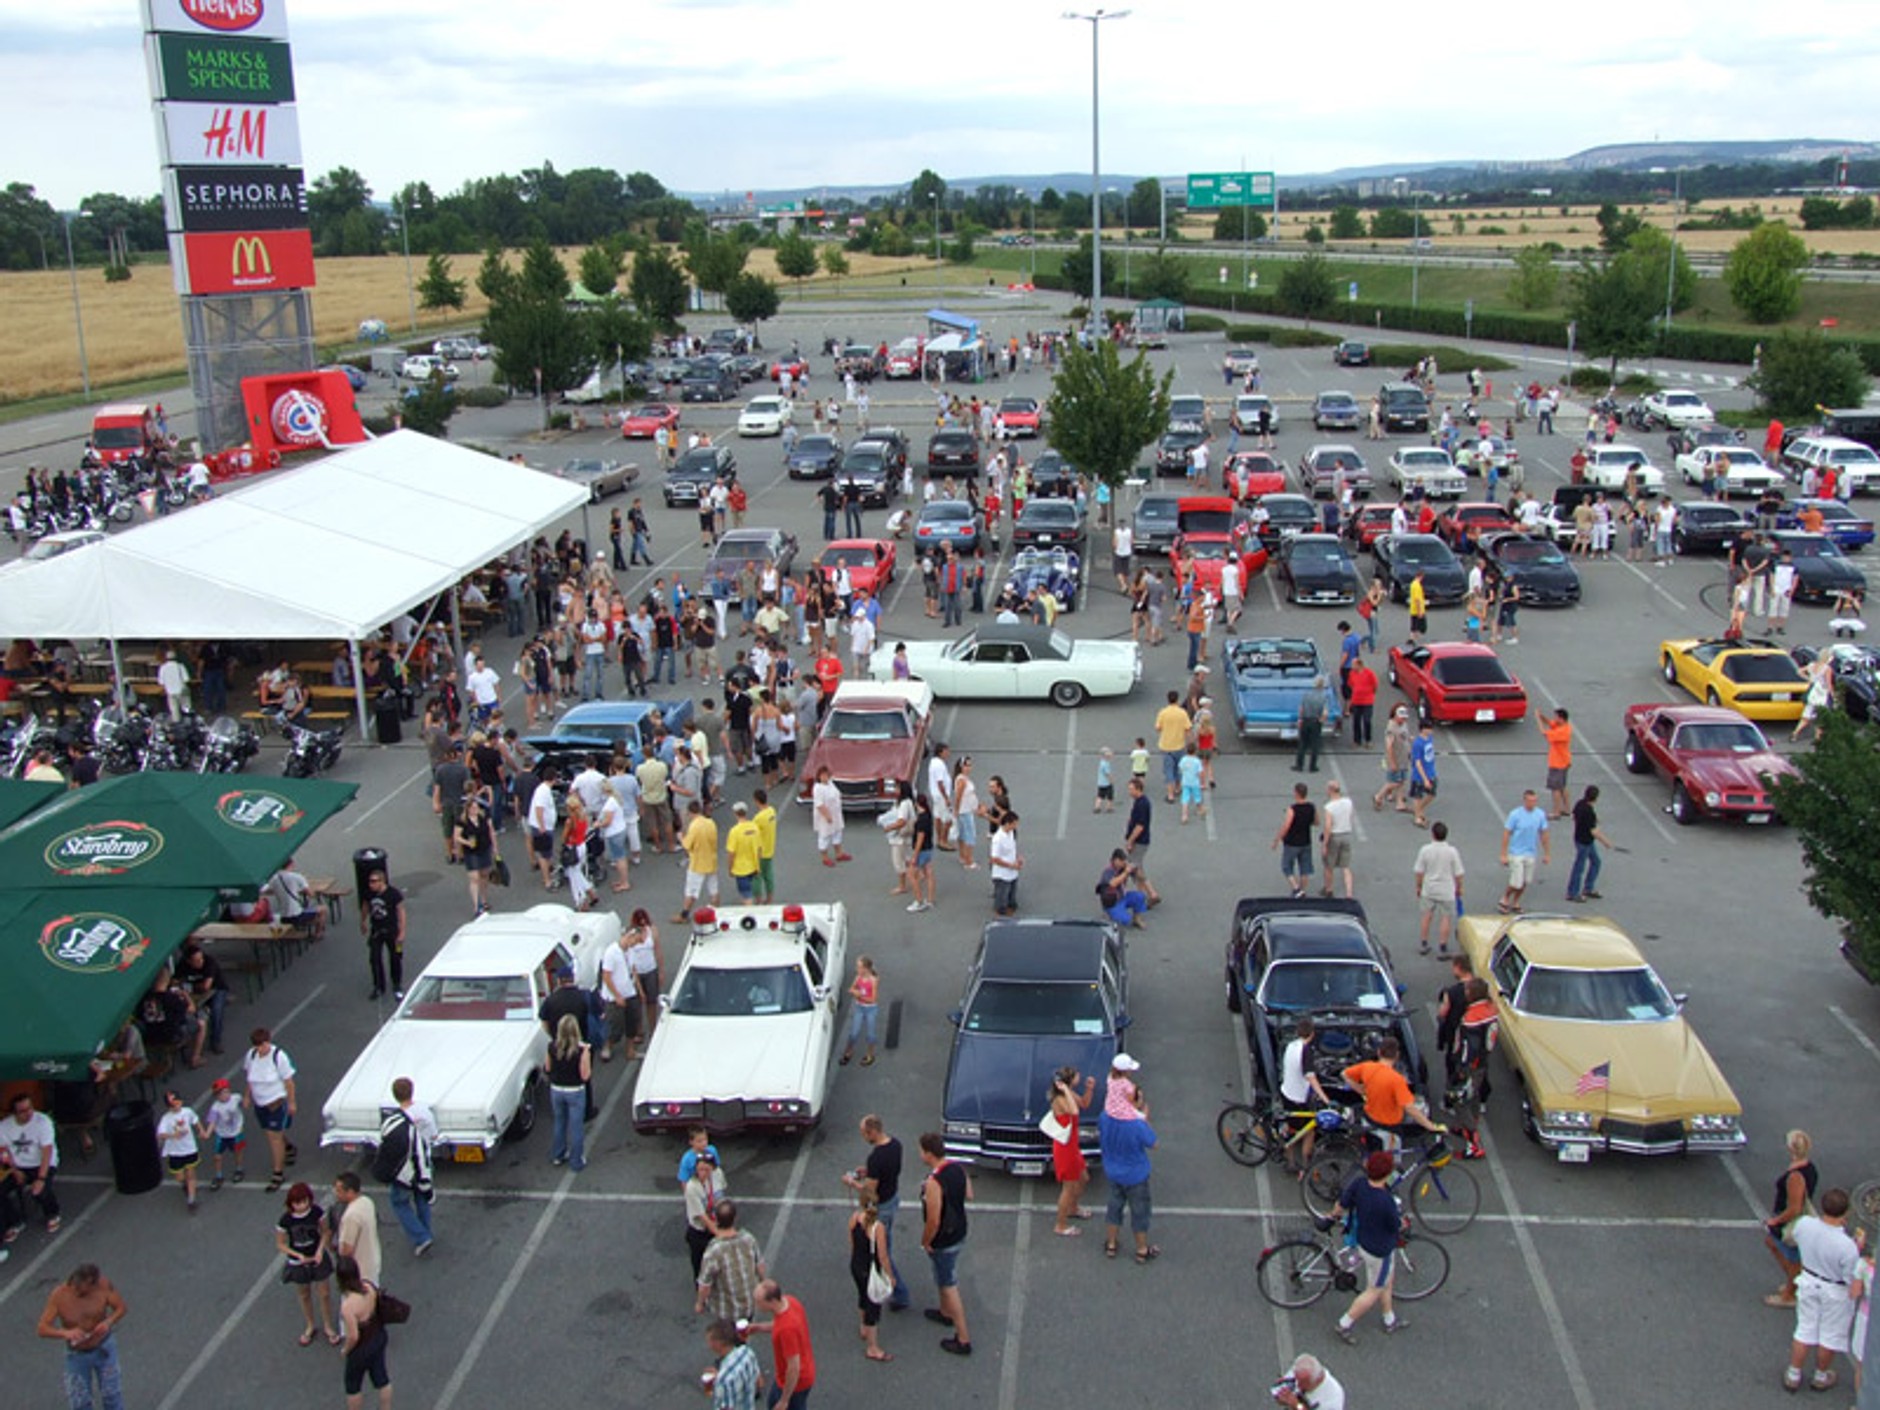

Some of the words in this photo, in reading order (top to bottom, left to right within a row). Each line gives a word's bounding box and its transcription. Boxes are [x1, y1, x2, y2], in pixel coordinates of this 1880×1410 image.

[186, 49, 252, 69] MARKS
[254, 51, 268, 70] &
[187, 68, 271, 90] SPENCER
[203, 107, 266, 159] H&M
[185, 184, 292, 203] SEPHORA
